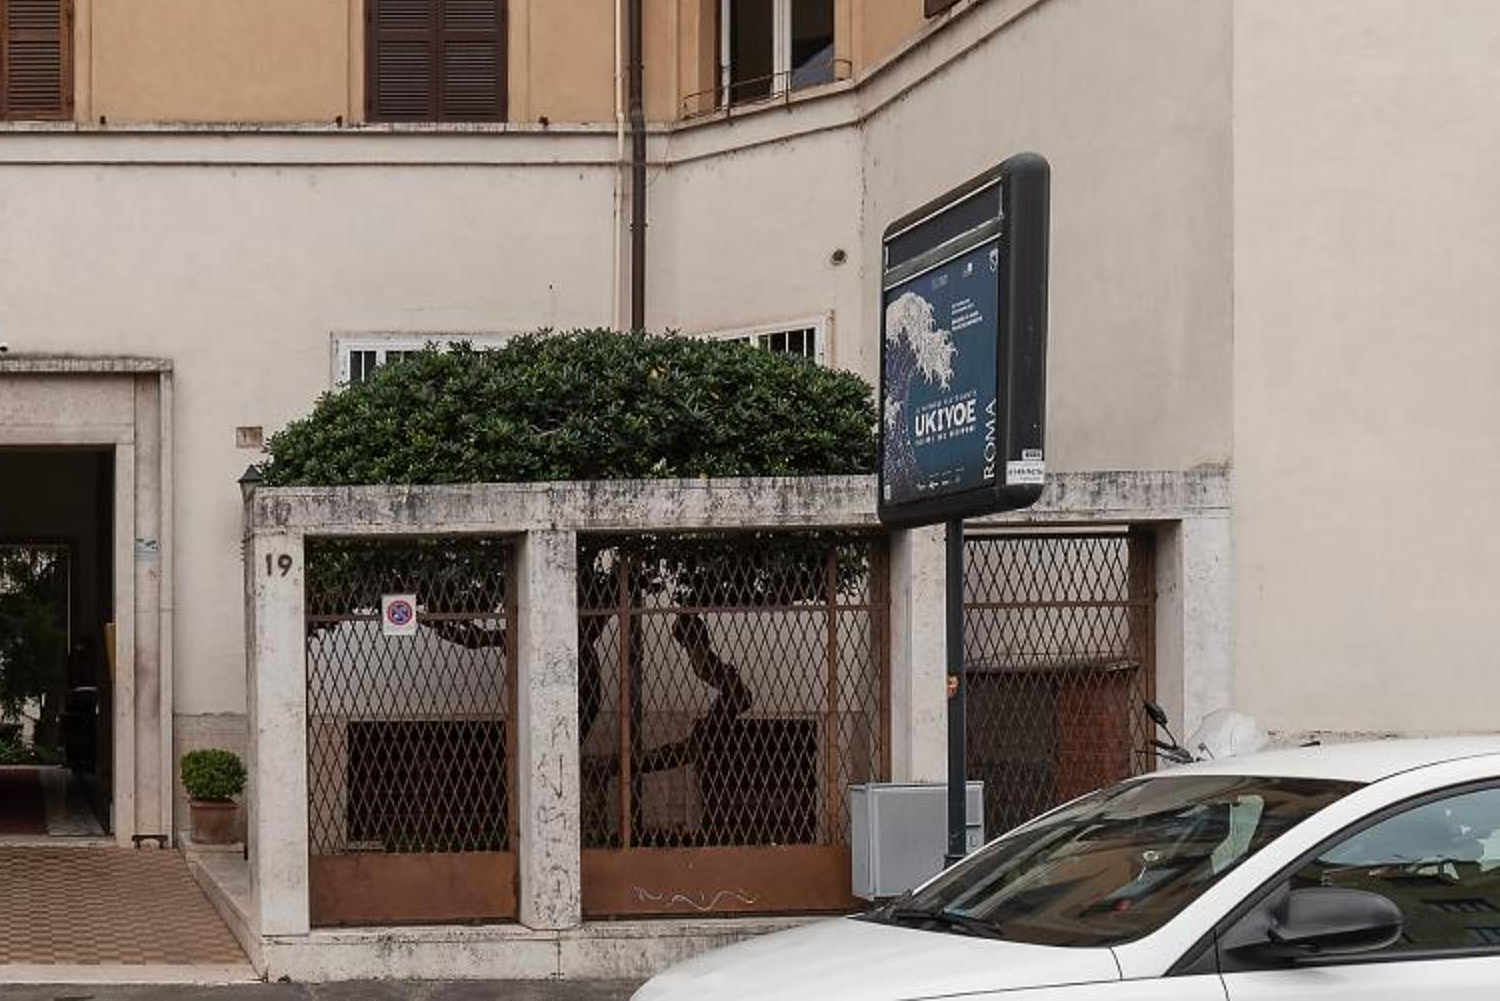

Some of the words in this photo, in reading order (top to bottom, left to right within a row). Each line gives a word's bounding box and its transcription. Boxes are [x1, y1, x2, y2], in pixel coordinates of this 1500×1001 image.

[915, 399, 977, 437] UKIYOE
[983, 398, 997, 480] ROMA
[266, 553, 293, 577] 19
